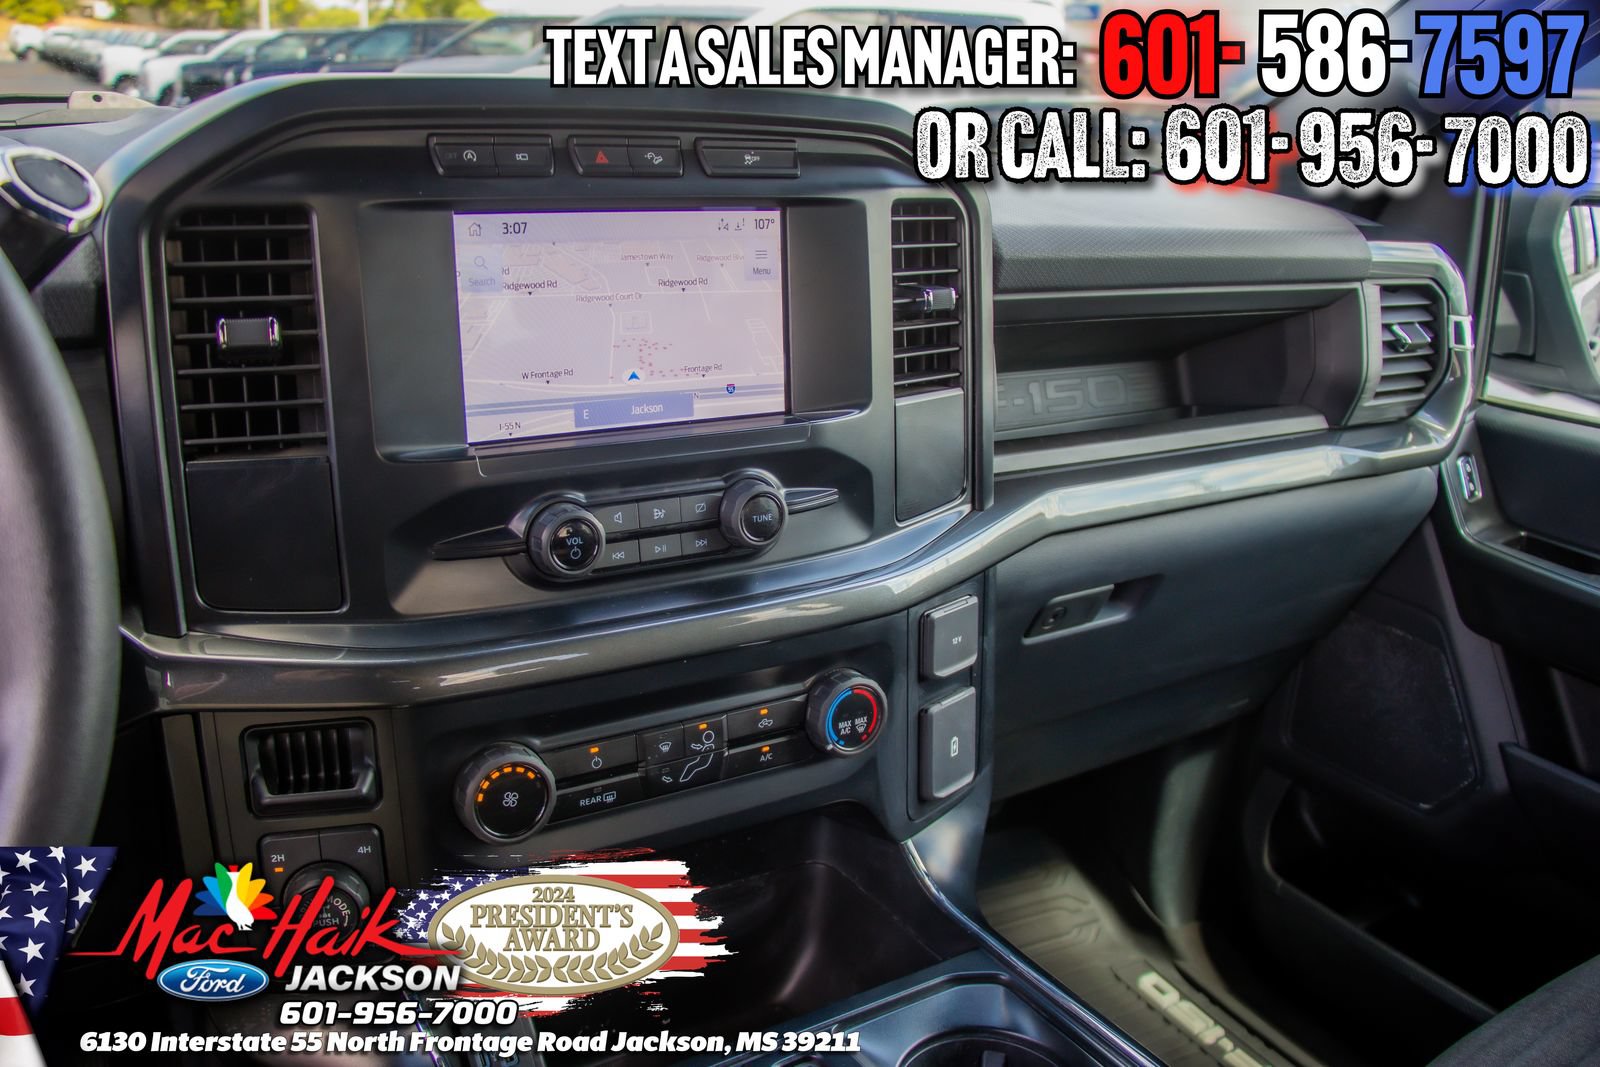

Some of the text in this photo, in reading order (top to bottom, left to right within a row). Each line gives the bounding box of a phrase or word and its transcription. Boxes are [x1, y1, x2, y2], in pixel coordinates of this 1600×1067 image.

[502, 222, 528, 235] 3:07
[752, 267, 771, 276] Menu
[468, 278, 496, 288] Search
[547, 280, 558, 289] Rd
[658, 277, 709, 288] Ridgewood Rd
[529, 369, 562, 381] Frontage
[563, 368, 574, 378] Rd
[997, 373, 1127, 414] -150
[584, 402, 664, 420] E Jackson
[752, 513, 773, 523] TUNE
[566, 537, 583, 546] VOL
[838, 720, 851, 729] MAX
[759, 751, 773, 763] A/C
[579, 795, 602, 807] REAR
[357, 845, 372, 854] 4H
[271, 854, 285, 863] 2H
